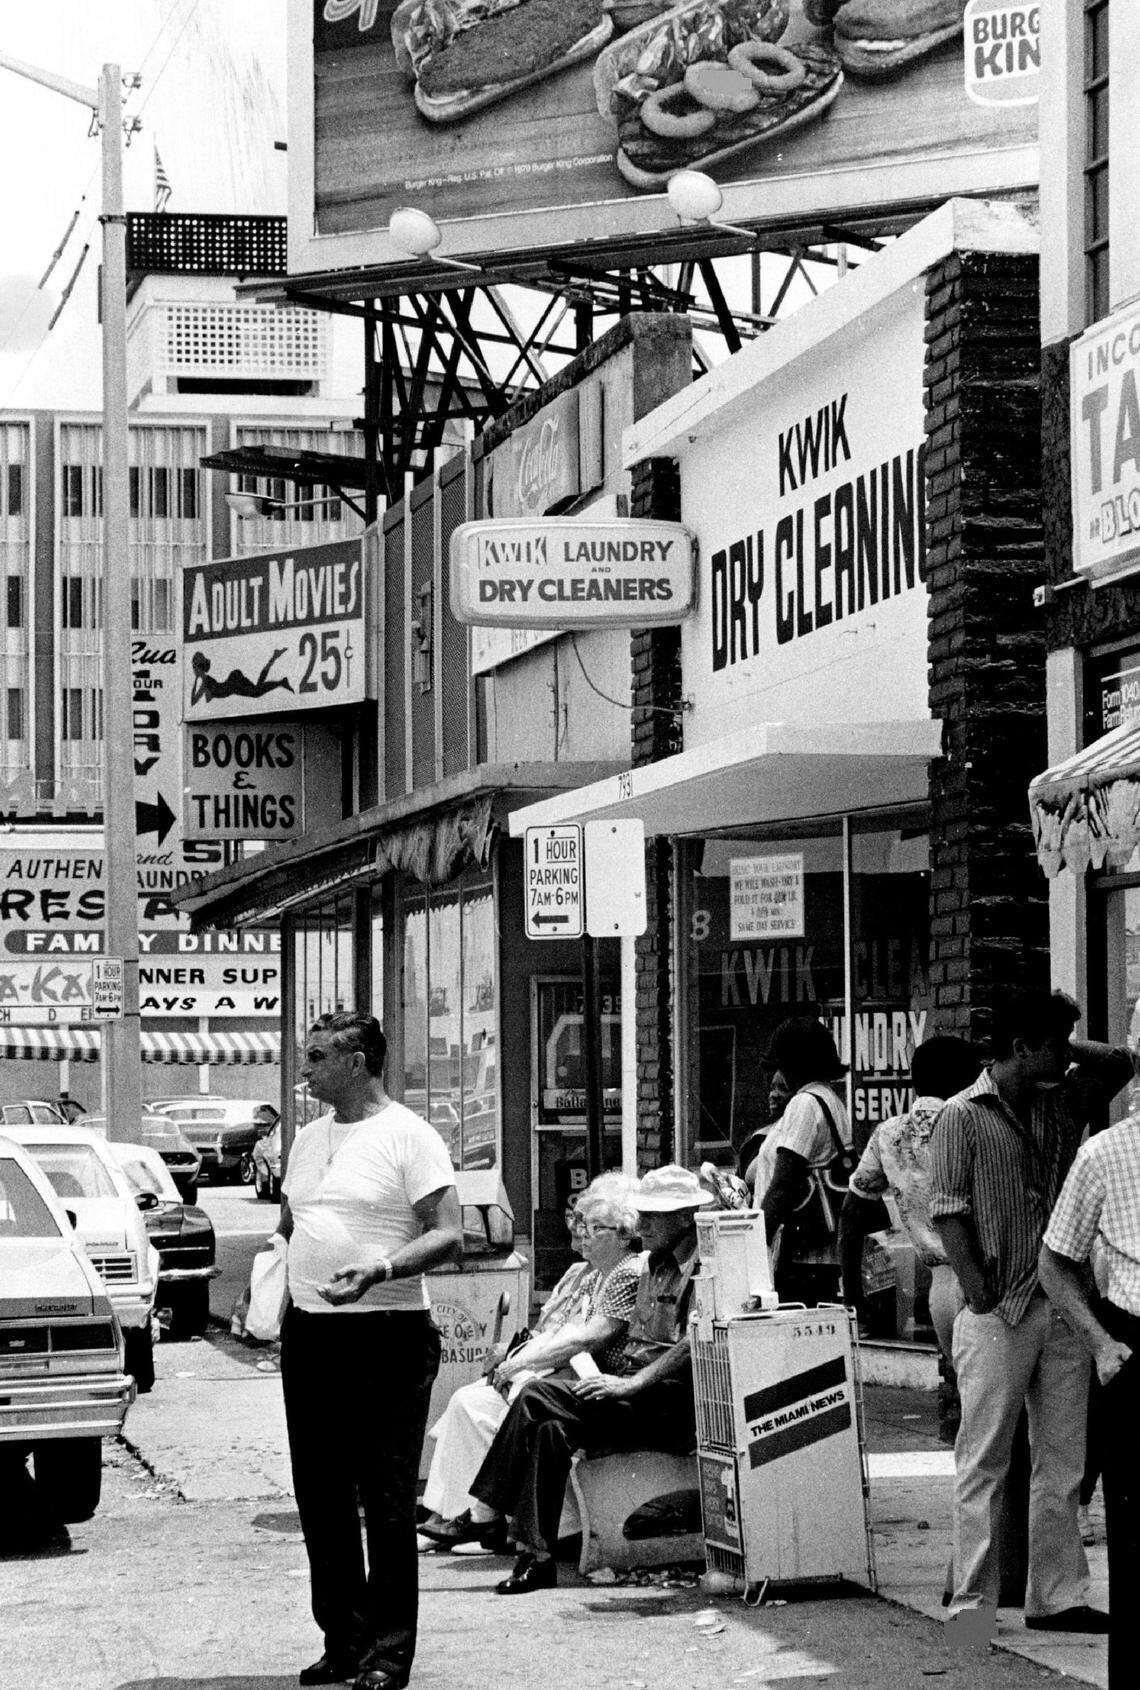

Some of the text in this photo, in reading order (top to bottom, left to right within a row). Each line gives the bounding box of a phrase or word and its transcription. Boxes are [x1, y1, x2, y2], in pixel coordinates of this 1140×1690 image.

[778, 393, 851, 497] KWIK
[478, 536, 674, 569] KWIK LAUNDRY
[591, 566, 611, 574] AND
[479, 577, 674, 602] DRY CLEANERS
[711, 529, 764, 672] DRY
[298, 628, 354, 694] 25¢
[133, 679, 163, 689] OUR
[192, 733, 295, 768] BOOKS
[233, 771, 256, 790] &
[192, 795, 295, 829] THINGS
[533, 838, 576, 863] 1 HOUR
[7, 859, 103, 879] AUTHEN
[530, 868, 578, 885] PARKING
[26, 933, 281, 952] FAMY DINNE
[139, 968, 278, 985] NNER SUP
[721, 939, 927, 1006] KWIK CLEA
[140, 996, 197, 1011] AYS
[854, 1088, 913, 1121] SERVI
[750, 1390, 845, 1437] THE MIAMI NEWS
